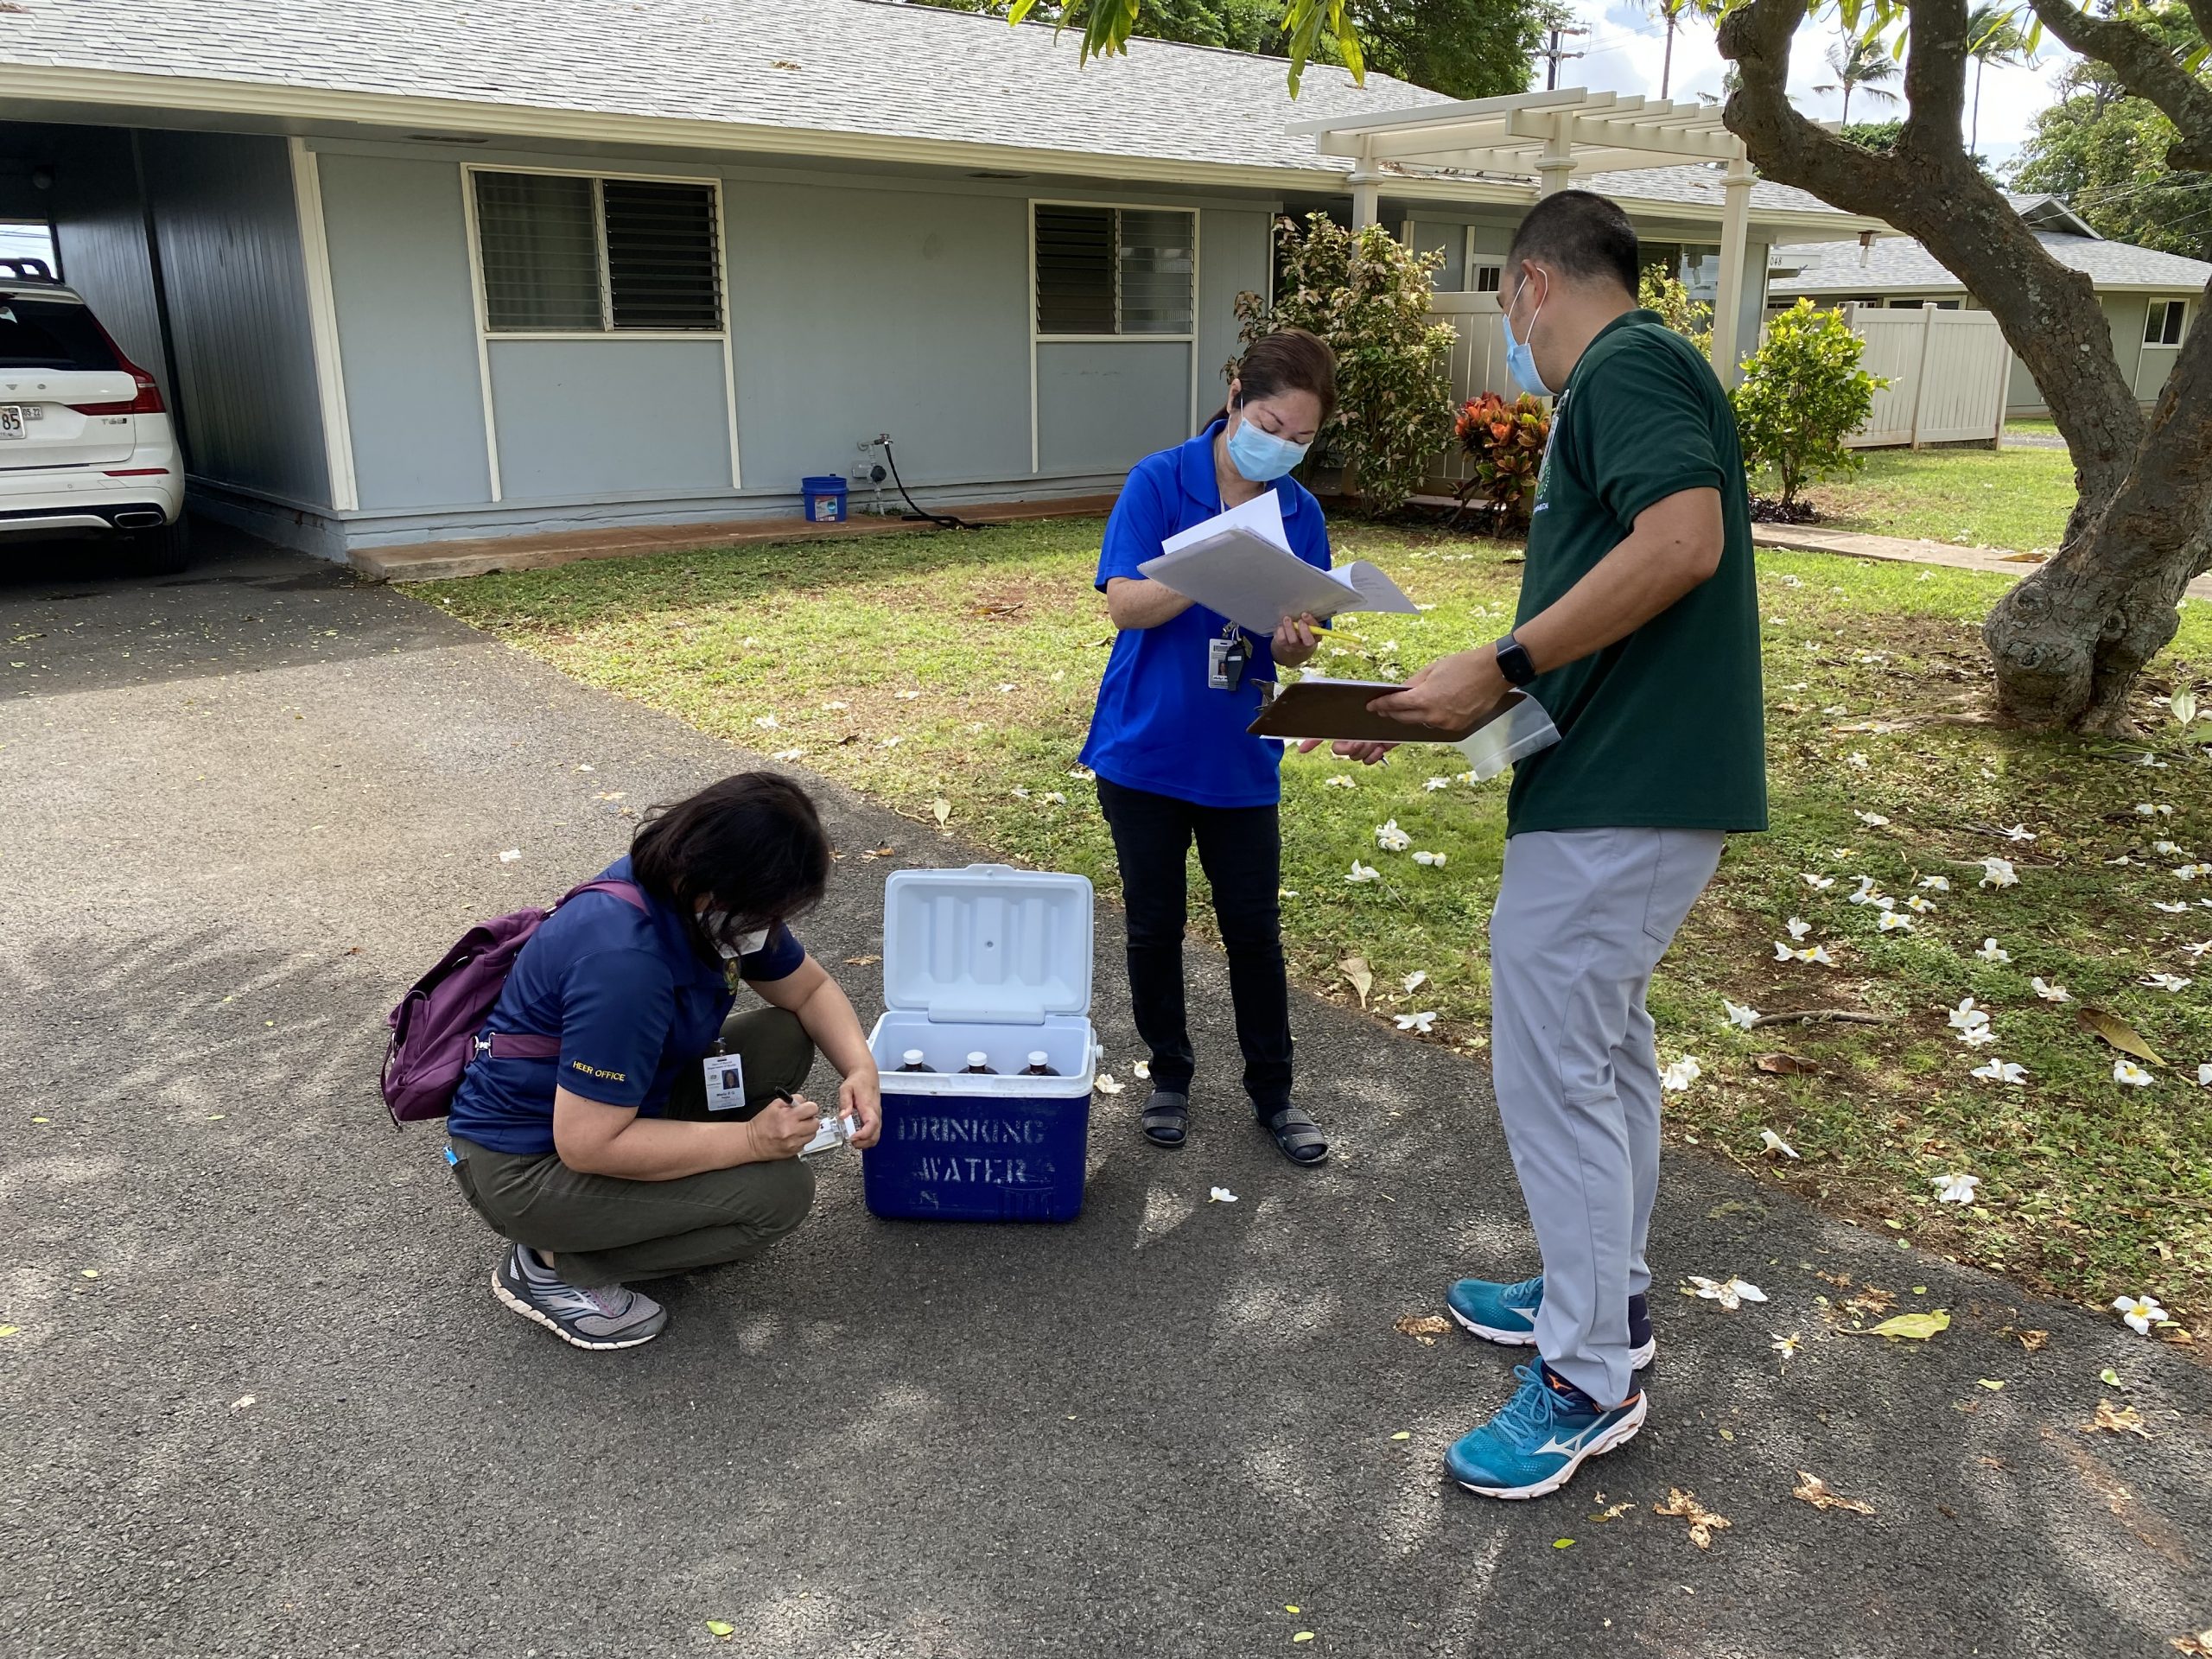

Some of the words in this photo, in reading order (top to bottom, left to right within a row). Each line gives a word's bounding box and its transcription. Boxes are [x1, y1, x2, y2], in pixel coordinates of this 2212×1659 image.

[2, 413, 21, 430] 85
[572, 1060, 594, 1075] HEER
[594, 1070, 626, 1082] OFFICE
[897, 1116, 1045, 1143] DRINKING
[916, 1157, 1027, 1184] WATER
